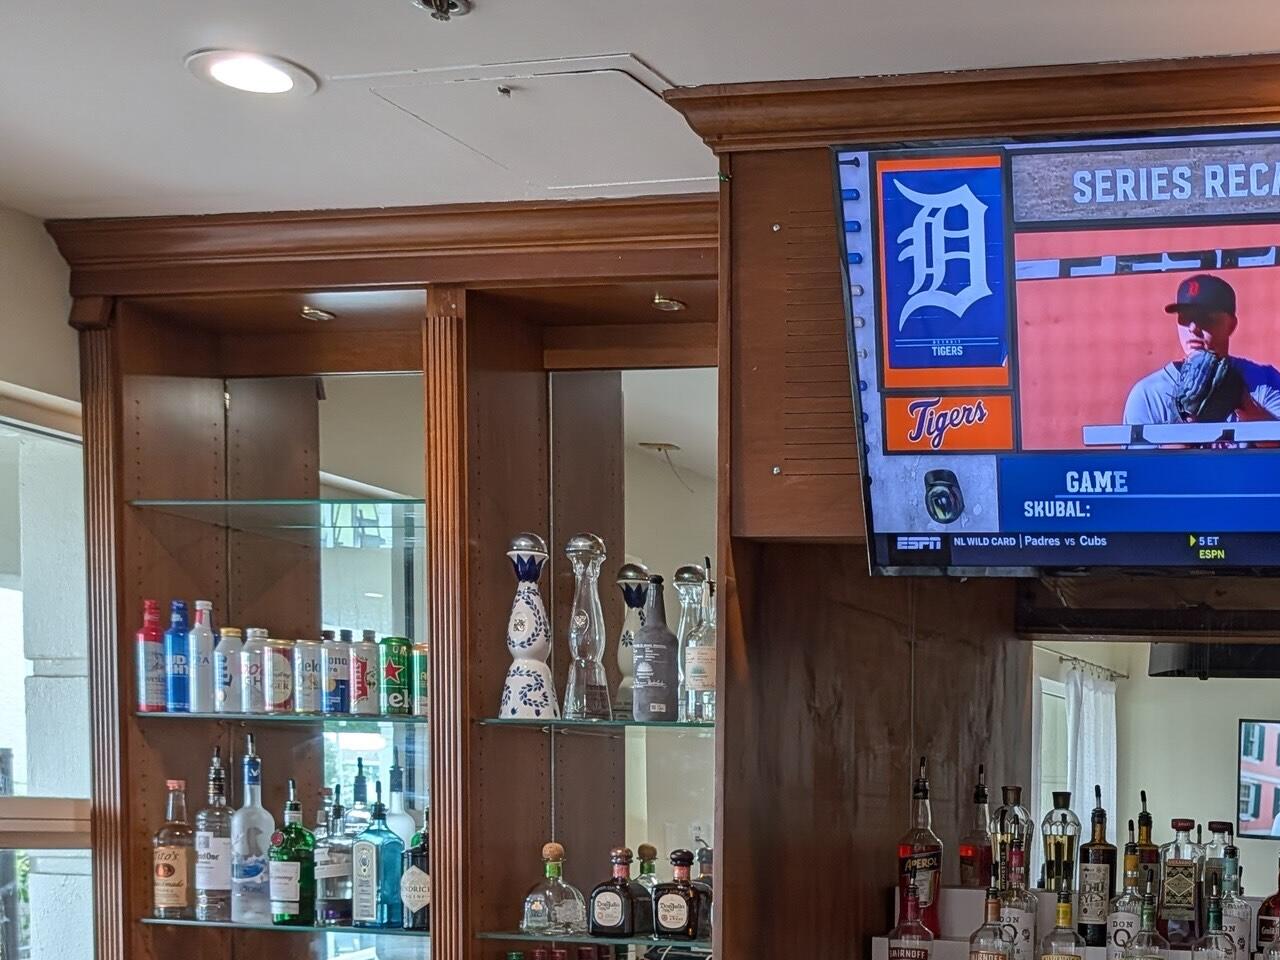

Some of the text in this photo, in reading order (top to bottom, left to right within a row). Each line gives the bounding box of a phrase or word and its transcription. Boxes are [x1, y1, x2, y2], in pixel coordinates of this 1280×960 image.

[1073, 166, 1192, 203] SERIES
[931, 346, 963, 356] TIGERS
[908, 396, 988, 449] Tigers
[1066, 470, 1128, 493] GAME
[1024, 501, 1091, 518] SKUBAL:
[897, 537, 941, 550] ESPN
[953, 535, 1107, 547] NL WILD CARD Padres vs Cubs
[1198, 536, 1219, 546] 5 ET
[1199, 549, 1225, 559] ESPN
[1112, 920, 1133, 928] DON
